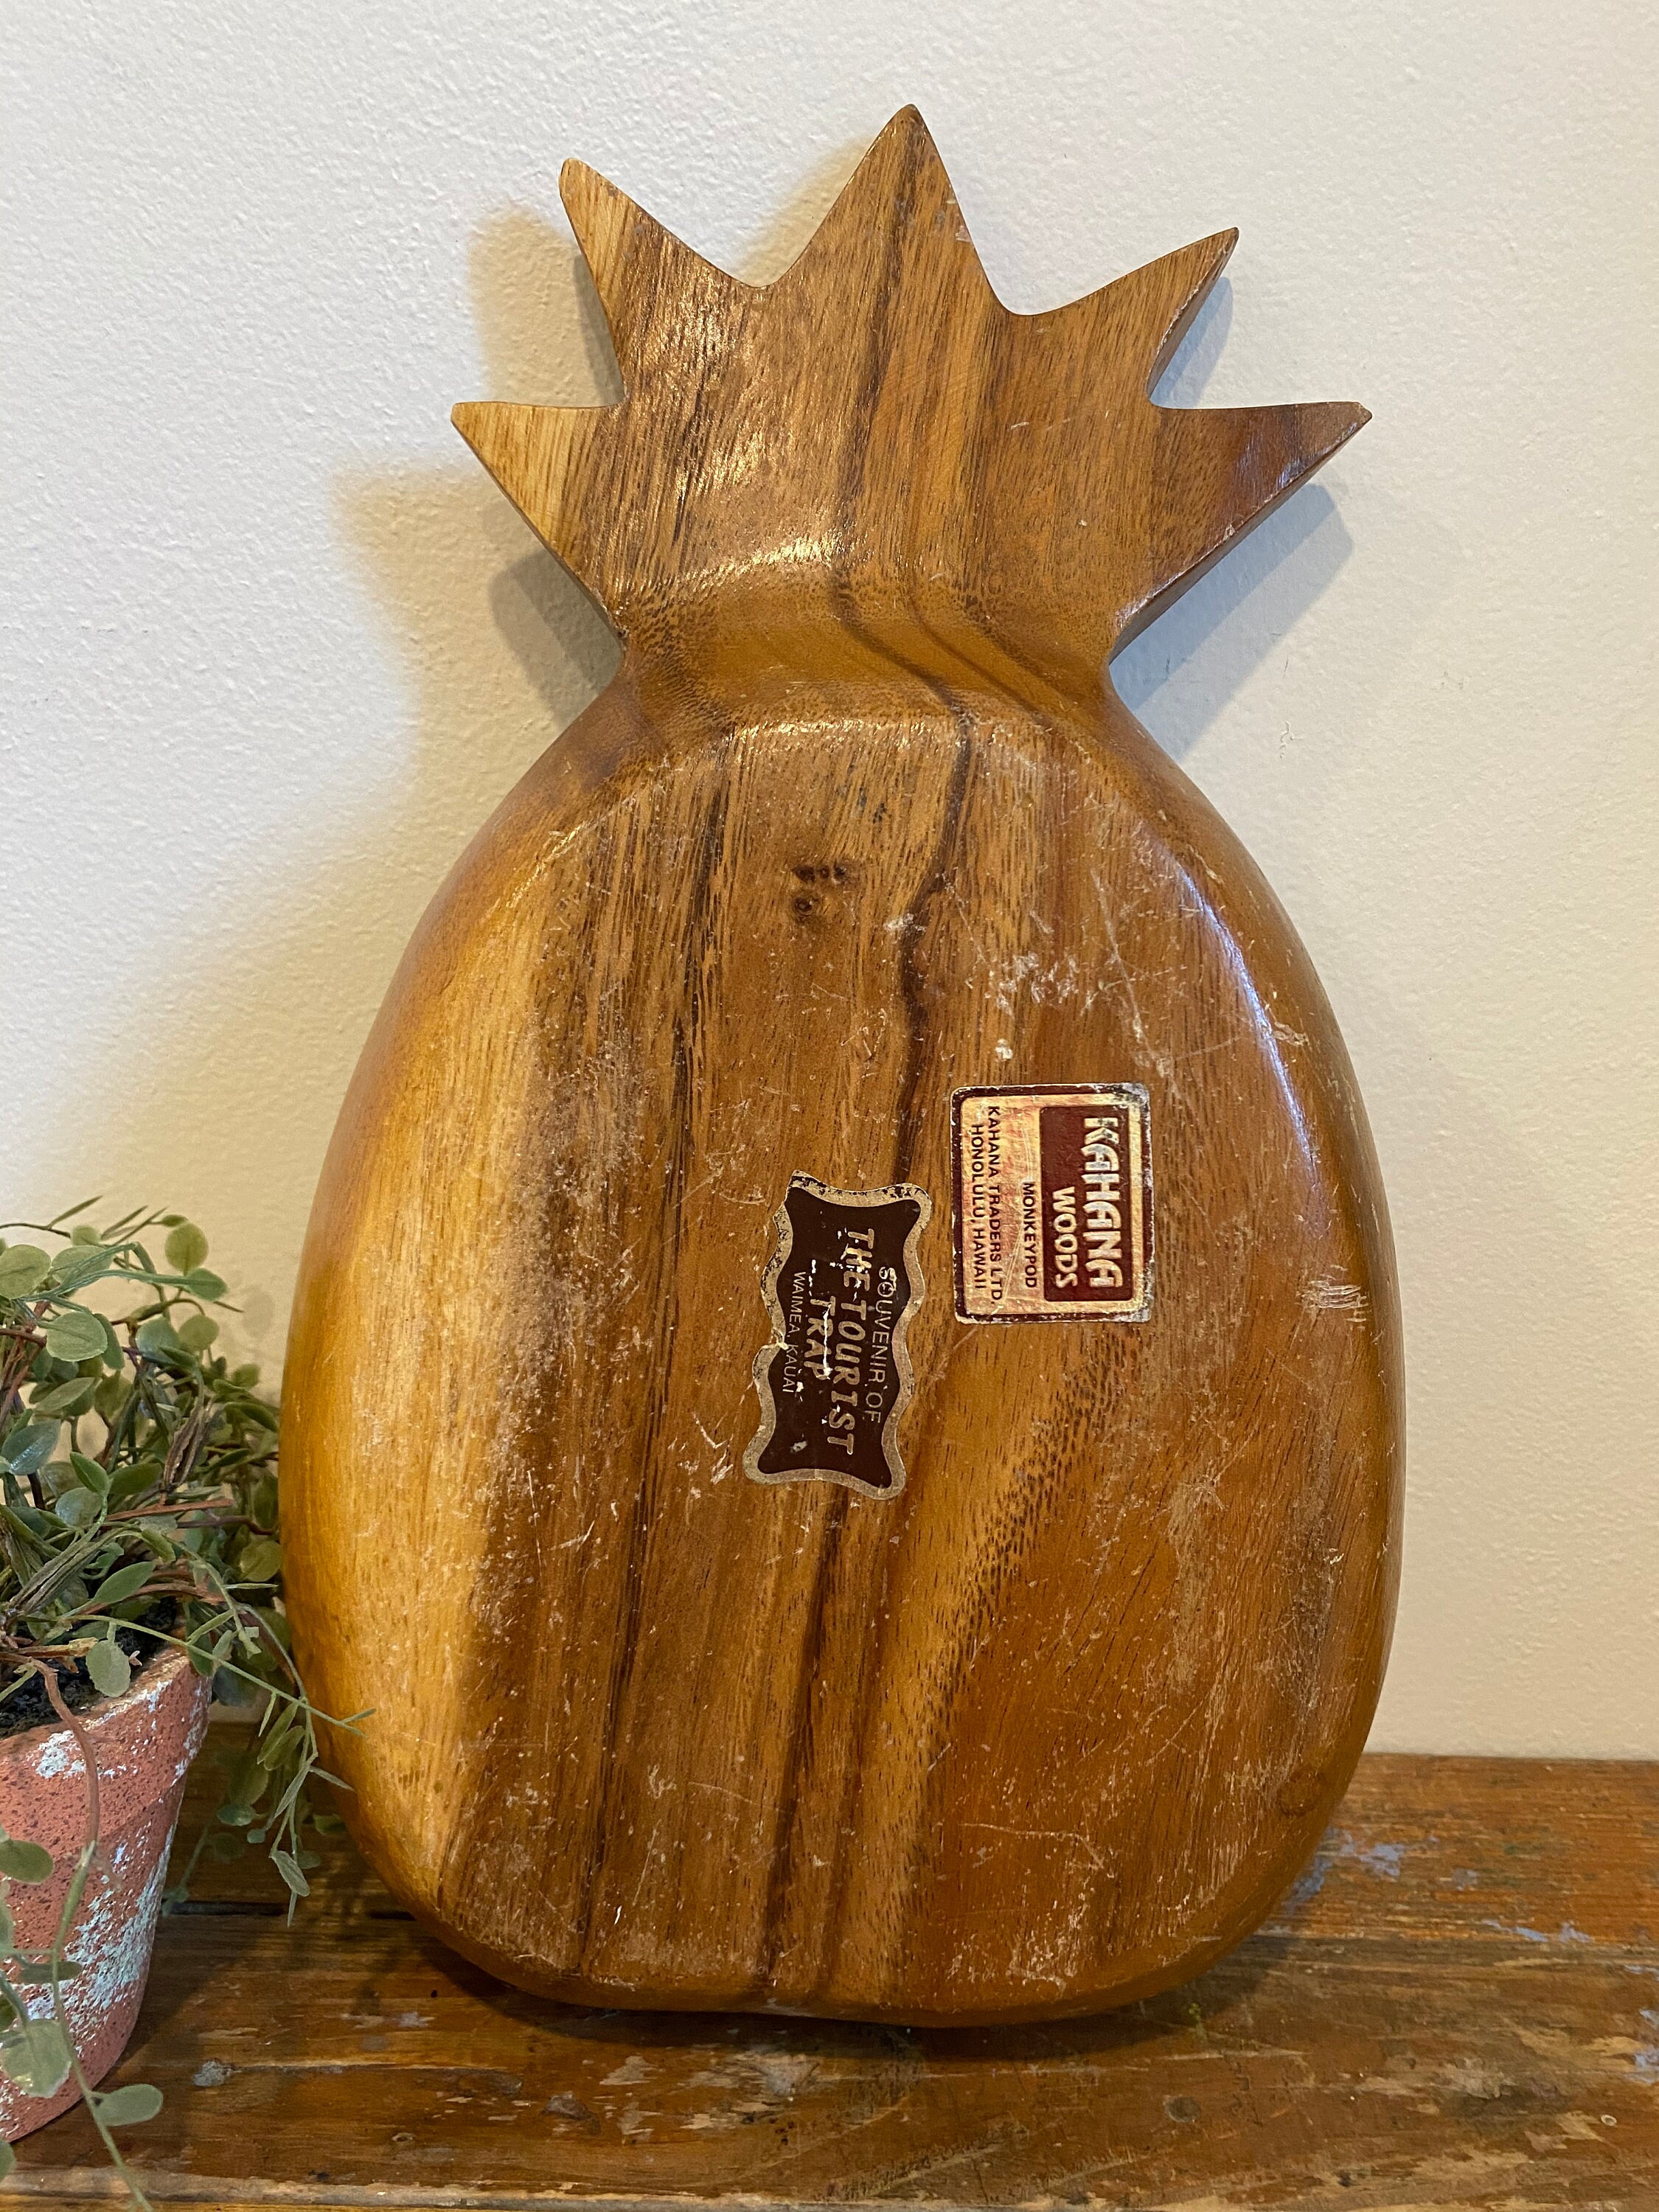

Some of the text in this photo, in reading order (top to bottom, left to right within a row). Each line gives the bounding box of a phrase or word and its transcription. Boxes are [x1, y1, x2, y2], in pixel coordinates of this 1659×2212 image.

[970, 1125, 986, 1289] HONOLULU, HAWAII
[987, 1106, 1003, 1305] KAHANA TRADERS LTD.
[1023, 1183, 1037, 1288] MONKEYPOD
[1052, 1186, 1078, 1288] WOODS
[1081, 1117, 1123, 1288] KAHANA
[782, 1271, 806, 1393] WAIMEA, KAUAI
[804, 1295, 836, 1380] TRAP
[827, 1228, 874, 1455] THE TOURIST
[863, 1266, 897, 1424] SOUVENIR OF
